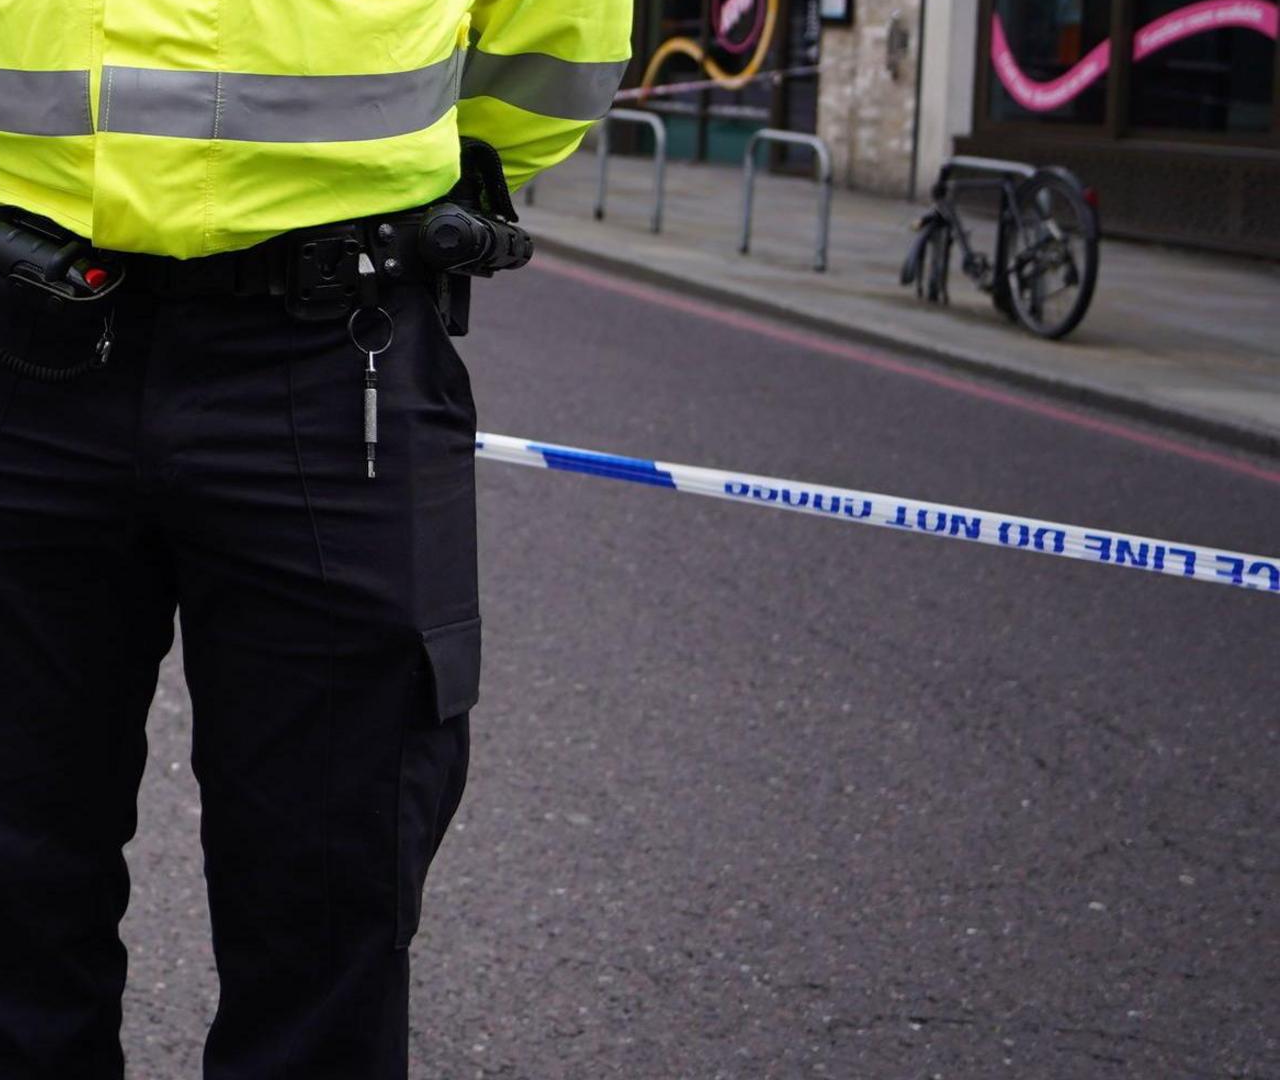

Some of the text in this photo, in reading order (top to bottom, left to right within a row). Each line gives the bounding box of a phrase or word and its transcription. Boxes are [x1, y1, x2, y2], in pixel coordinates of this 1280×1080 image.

[885, 505, 981, 540] NOT
[998, 522, 1068, 554] DO
[1083, 535, 1198, 576] LINE
